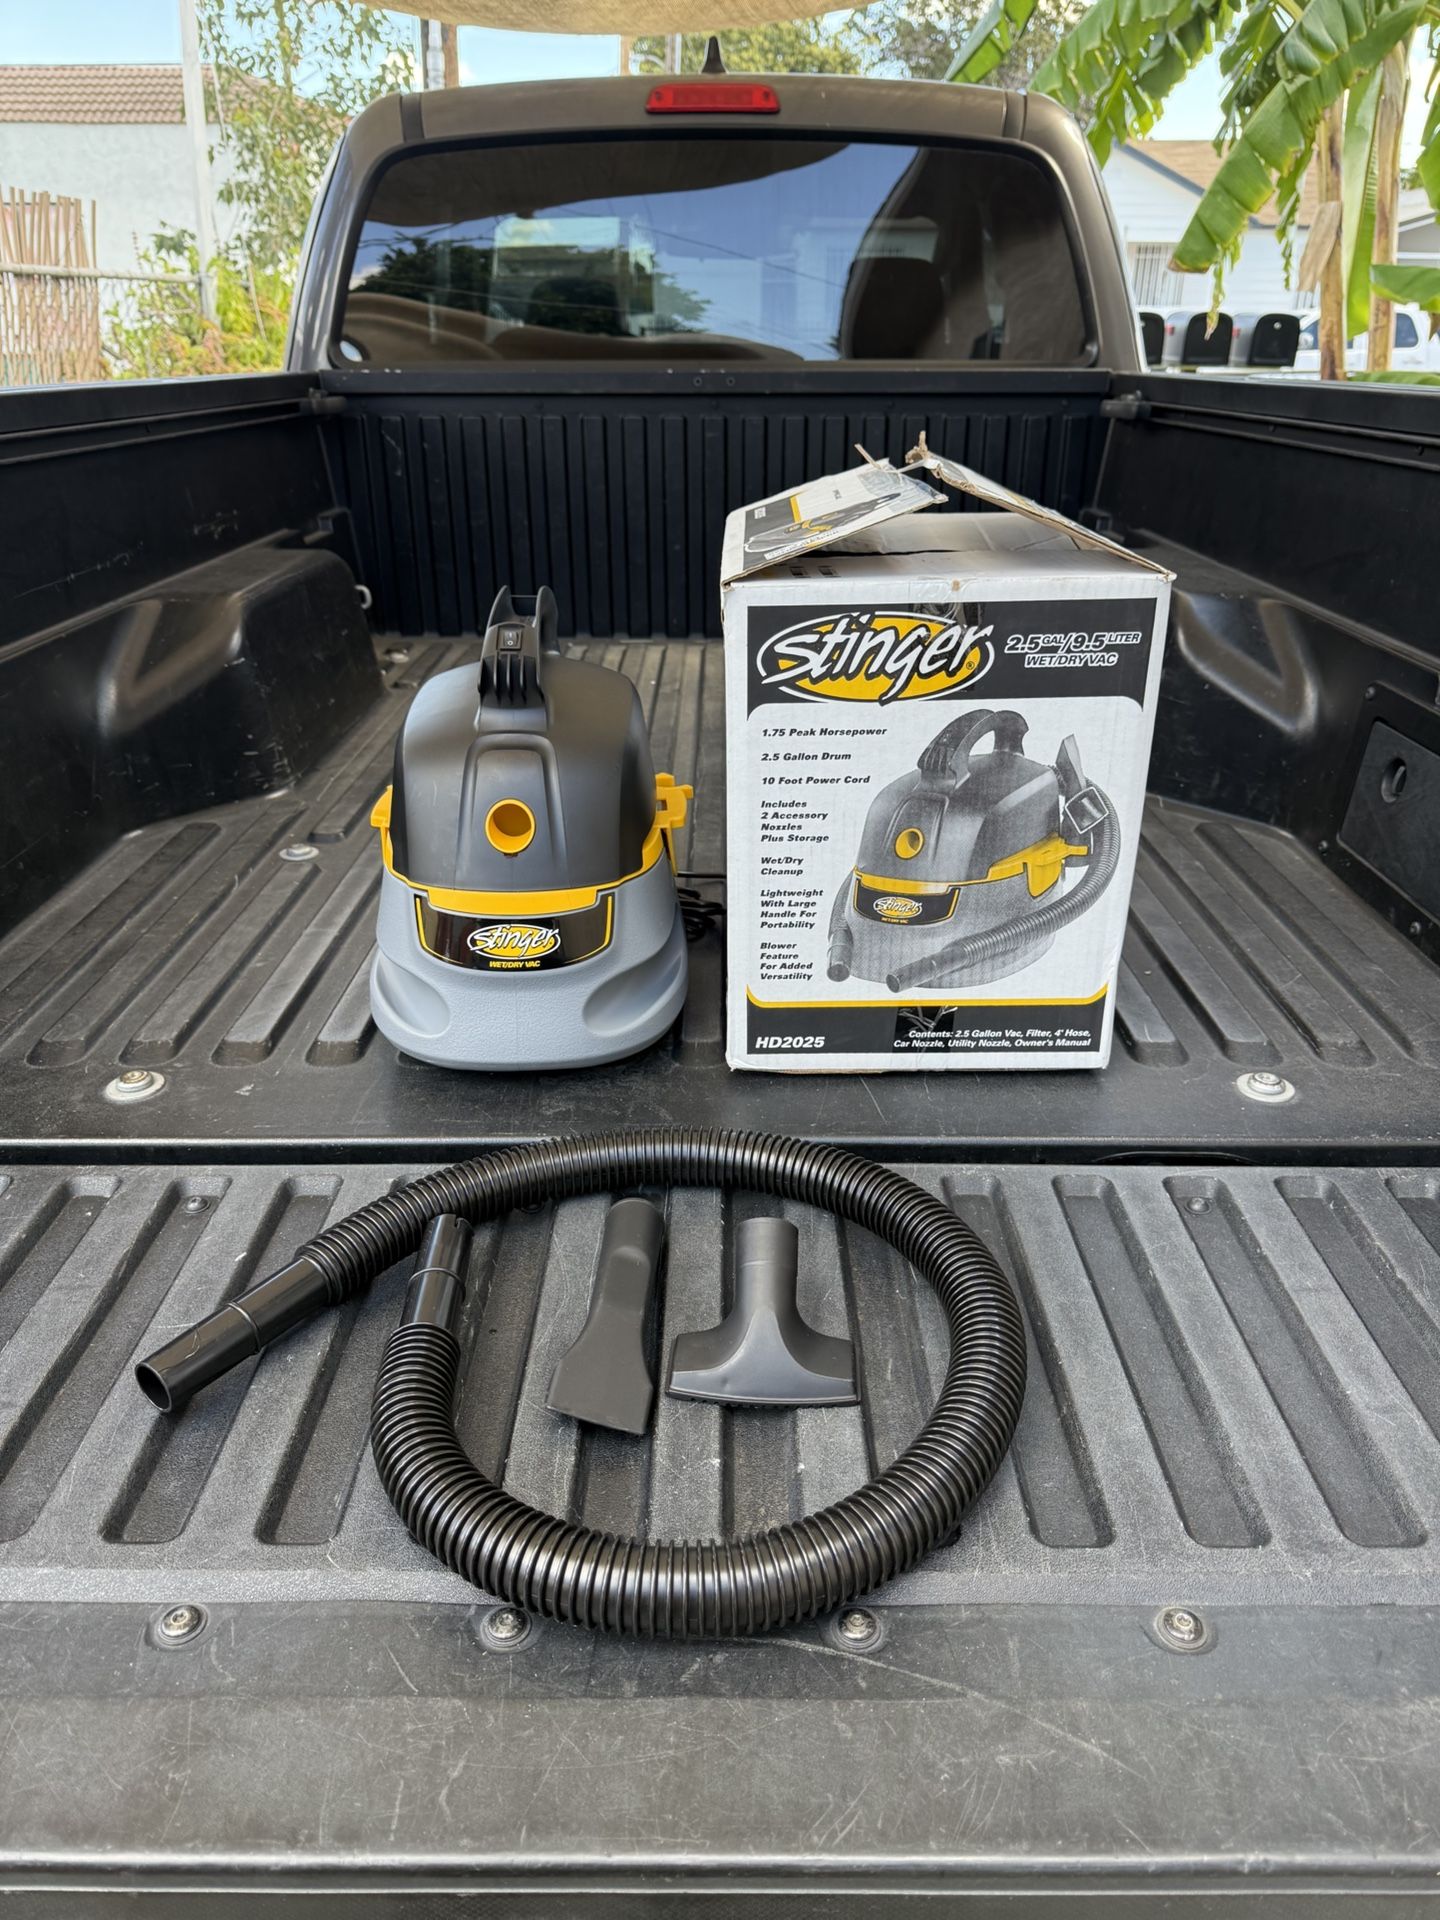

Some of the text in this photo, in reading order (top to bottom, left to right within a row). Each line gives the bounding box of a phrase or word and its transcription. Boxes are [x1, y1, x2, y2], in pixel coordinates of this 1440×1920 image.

[762, 728, 888, 738] 1.75 Peak Horsepower
[761, 752, 852, 761] 2.5 Gallon Drum
[762, 775, 871, 785] 10 Foot Power Cord
[761, 800, 807, 809] Includes
[761, 812, 828, 821] 2 Accessory
[761, 823, 803, 831] Nozzles
[761, 834, 829, 844] Plus Storage
[761, 857, 804, 866] Wet/Dry
[761, 868, 803, 876] Cleanup
[760, 889, 824, 898] Lightweight
[761, 900, 817, 909] With Large
[799, 910, 817, 918] For
[760, 921, 815, 929] Portability
[760, 942, 797, 950] Blower
[489, 960, 541, 969] WET/DRY VAC
[779, 962, 813, 970] Added
[760, 972, 813, 981] Versatility
[908, 1030, 954, 1038] Contents:
[954, 1030, 970, 1038] 2.5
[971, 1029, 1002, 1038] Gallon
[1004, 1029, 1024, 1038] Vac,
[1025, 1028, 1052, 1038] Filter,
[1064, 1028, 1091, 1038] Hose,
[755, 1036, 825, 1049] HD2025
[893, 1038, 1092, 1049] Car Nozzle, Utility Nozzle, Owner's Manual
